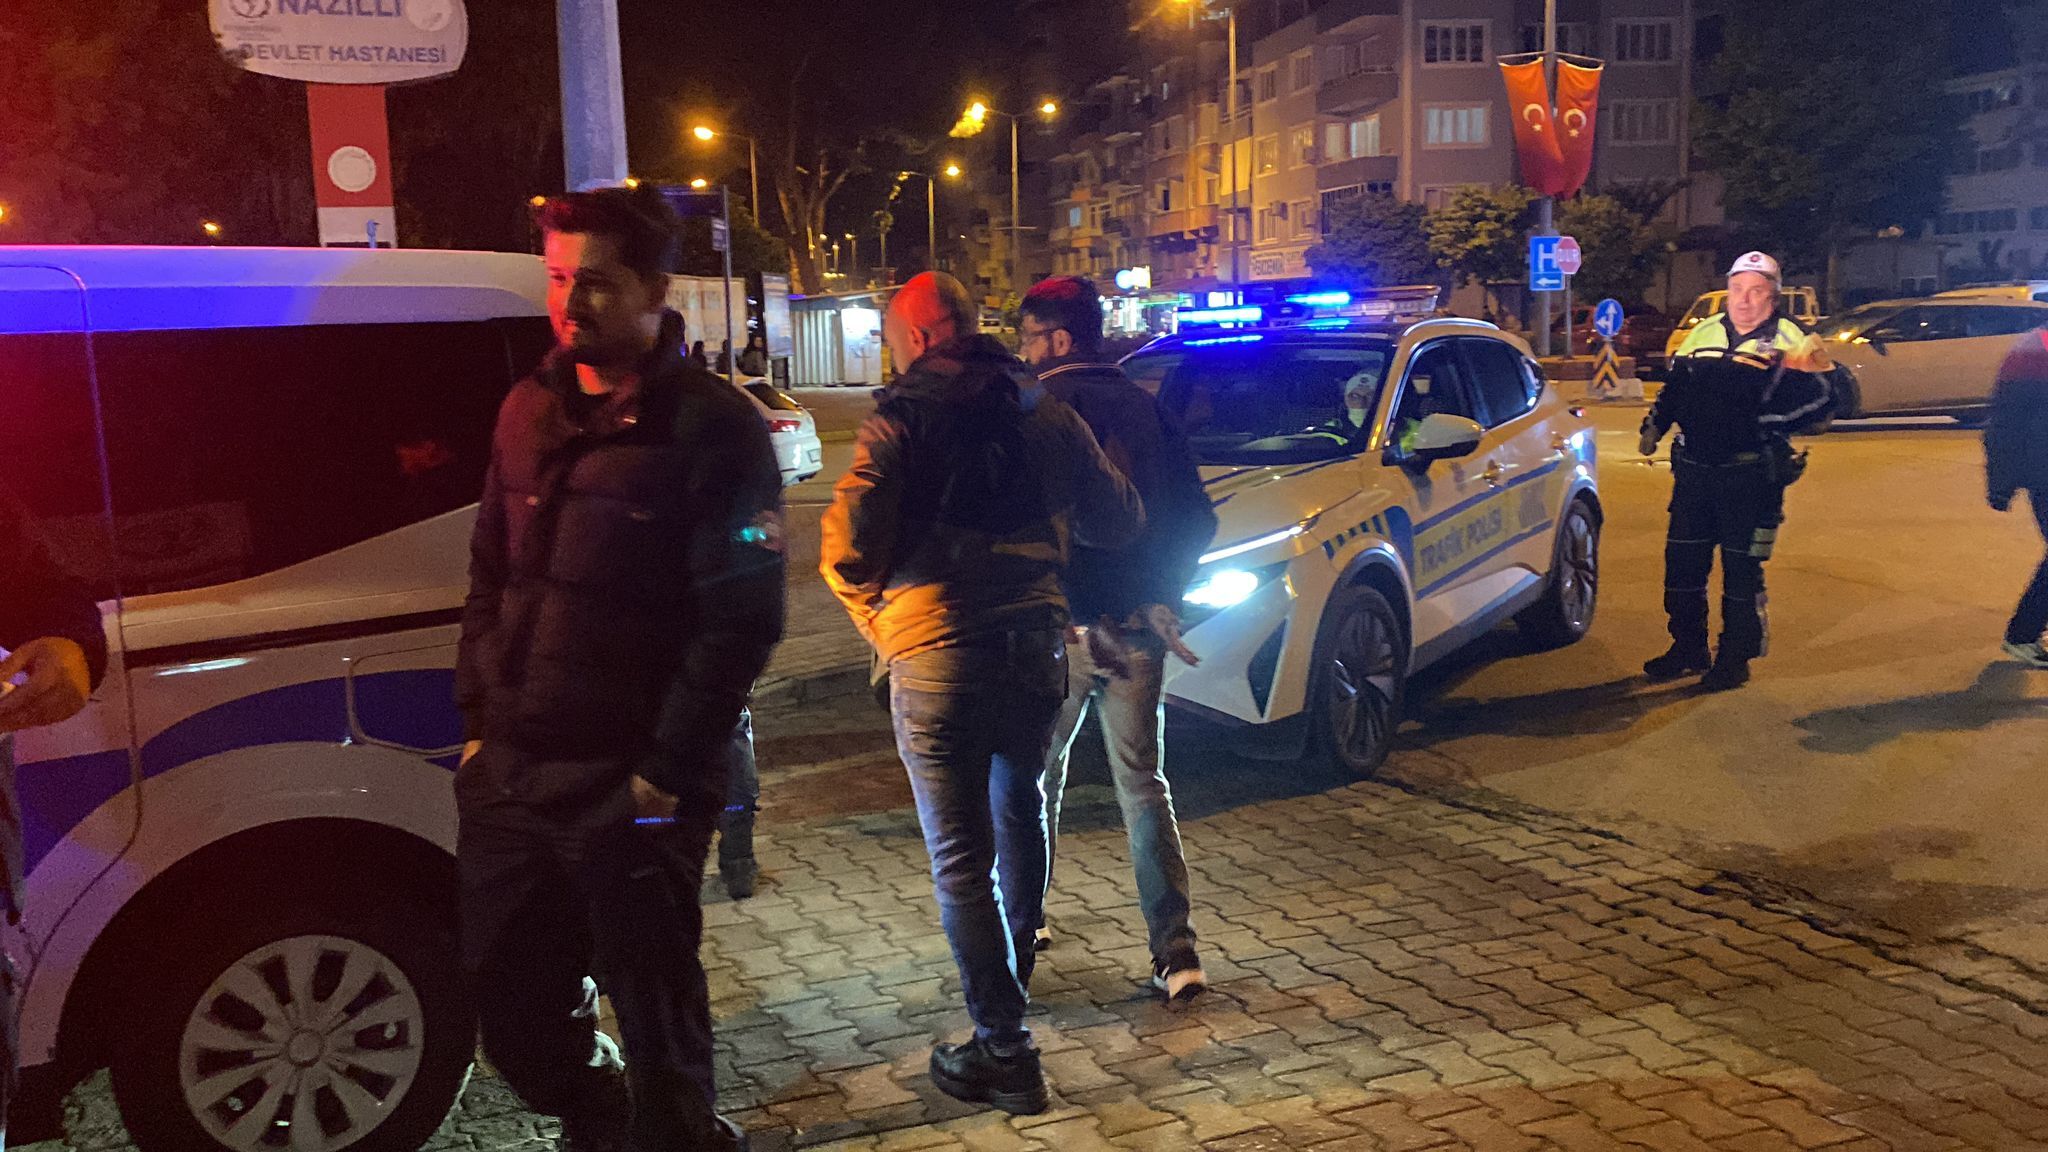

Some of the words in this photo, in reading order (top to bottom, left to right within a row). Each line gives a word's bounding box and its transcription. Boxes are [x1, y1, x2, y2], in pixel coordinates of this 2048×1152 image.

[239, 43, 323, 60] DEVLET
[328, 43, 447, 63] HASTANESİ
[1538, 243, 1558, 272] H
